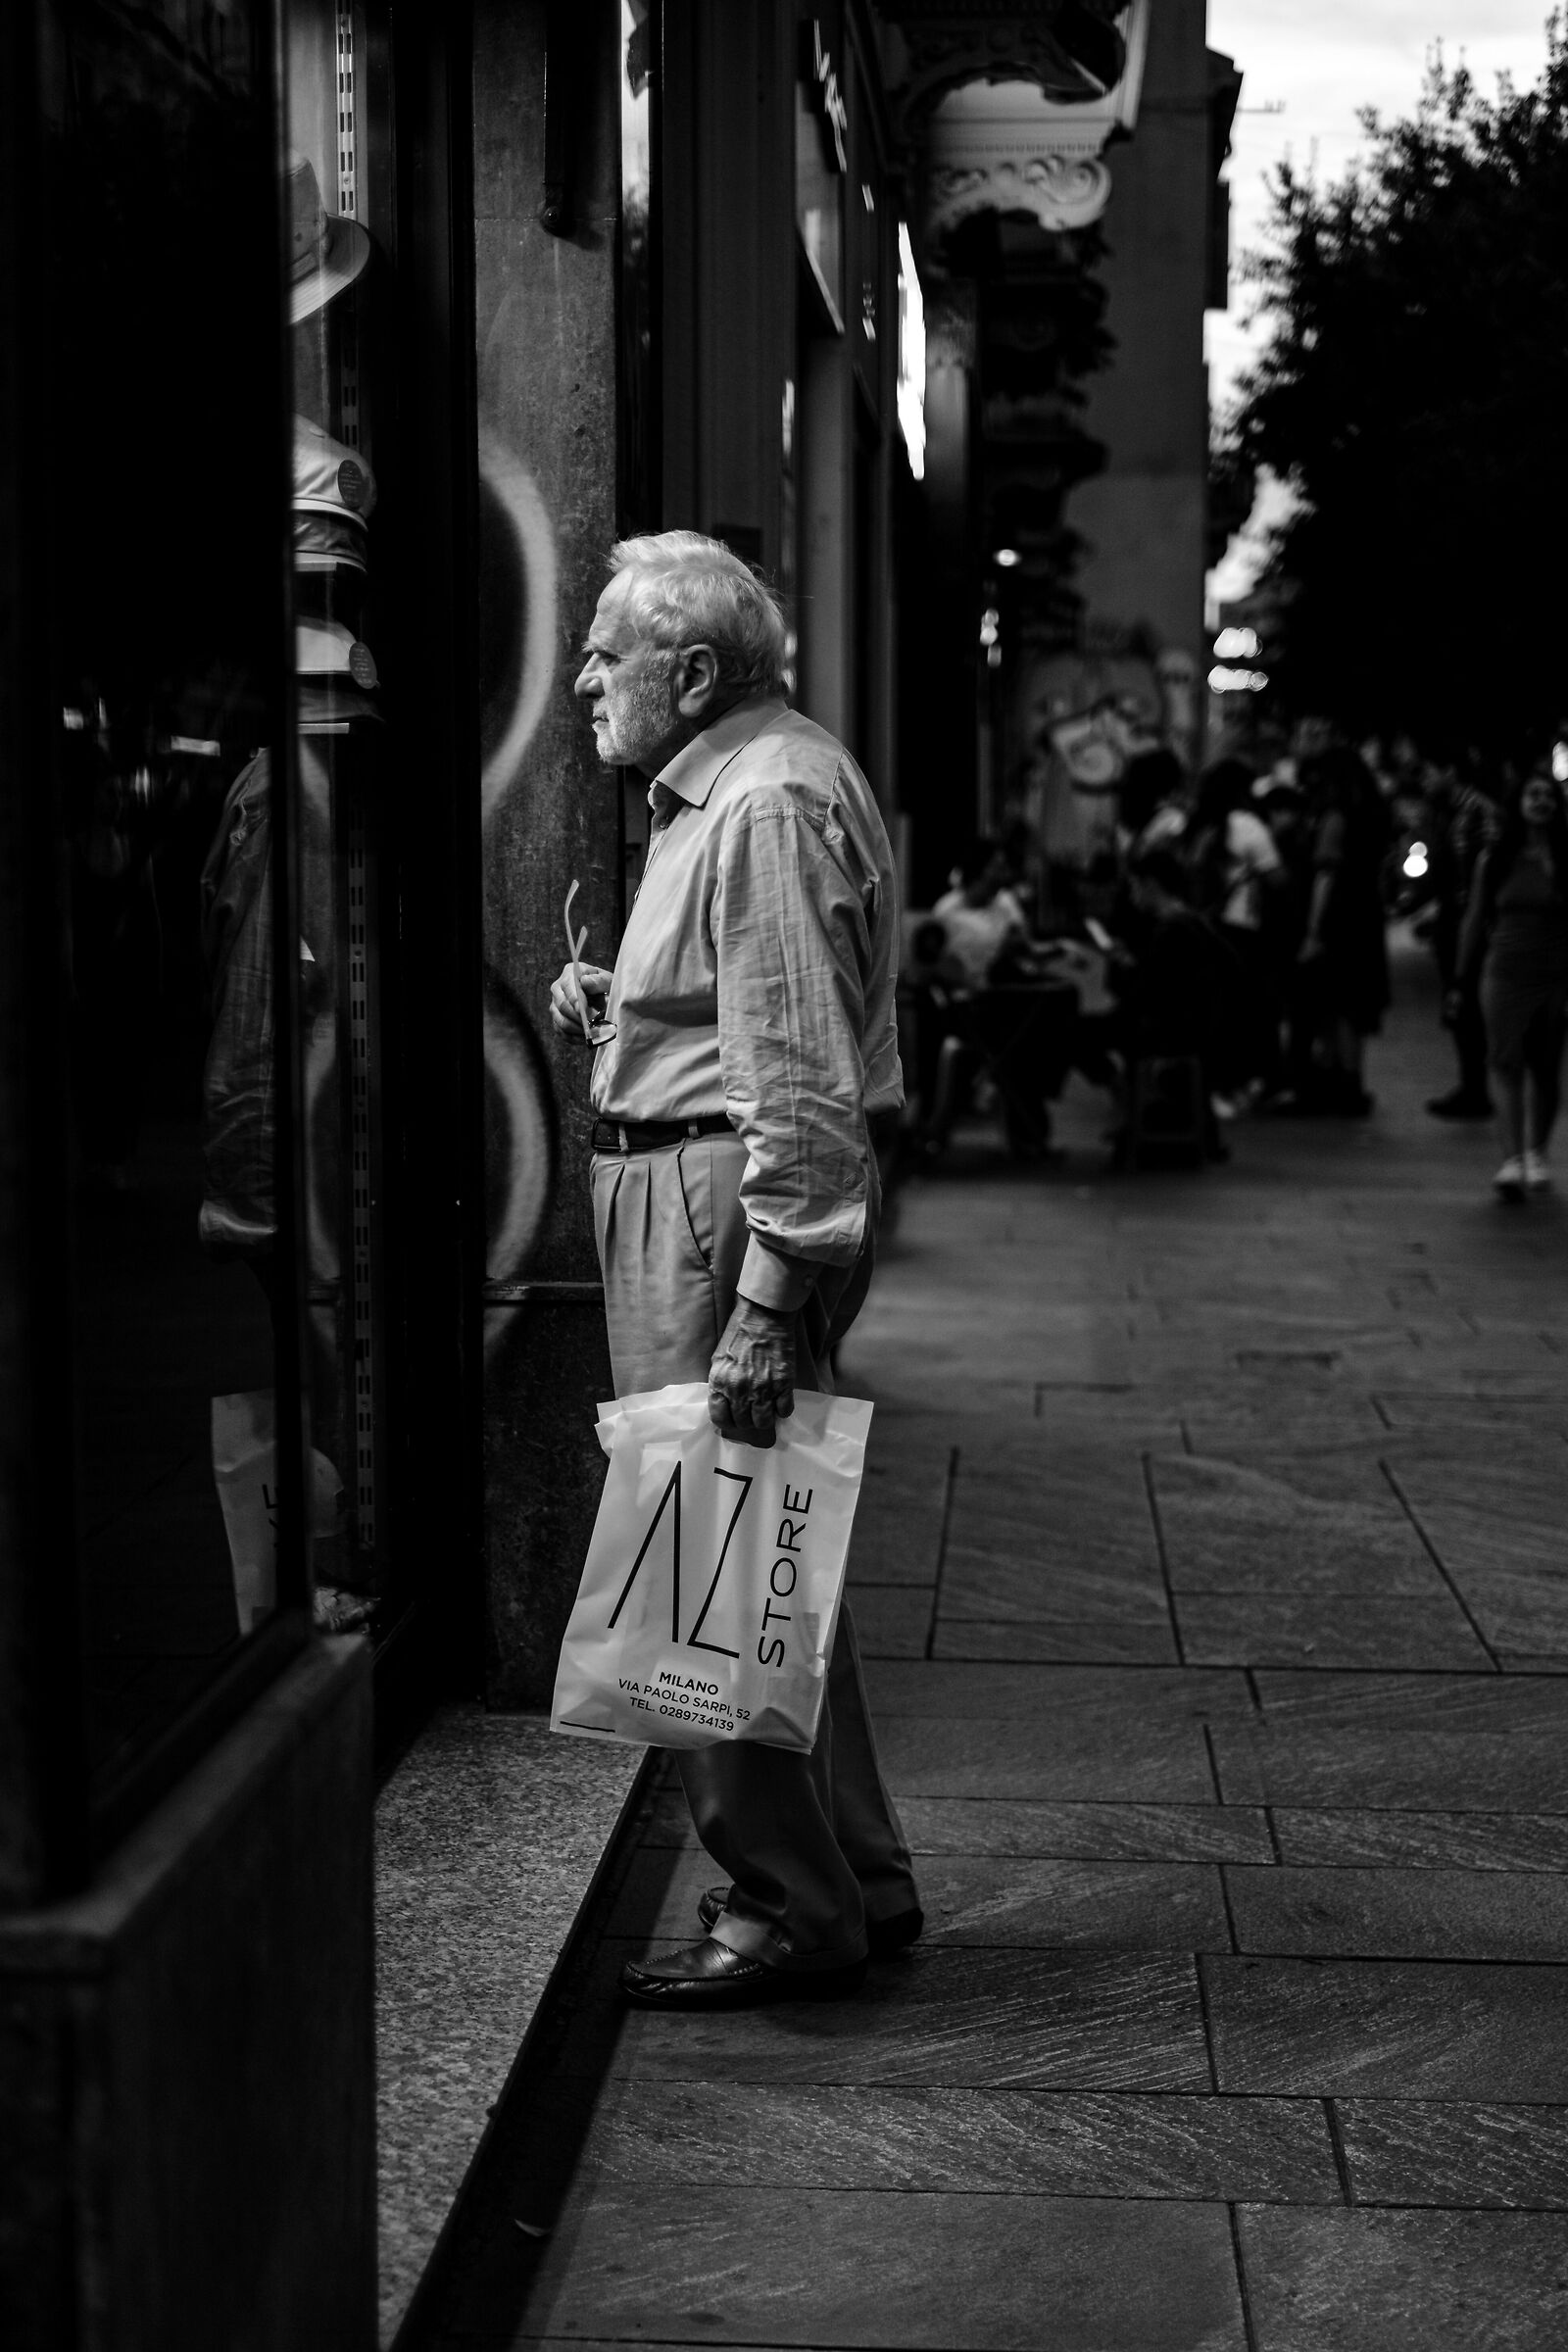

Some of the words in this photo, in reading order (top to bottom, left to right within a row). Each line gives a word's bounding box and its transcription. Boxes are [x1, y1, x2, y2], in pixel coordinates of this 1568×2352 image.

[758, 1484, 812, 1667] STORE
[618, 1678, 640, 1693] VIA
[644, 1685, 690, 1707] PAOLO
[692, 1695, 733, 1719] SARPI,
[736, 1708, 751, 1721] 52
[659, 1671, 719, 1696] MILANO
[629, 1696, 656, 1713] TEL.
[660, 1704, 735, 1733] 0289734139
